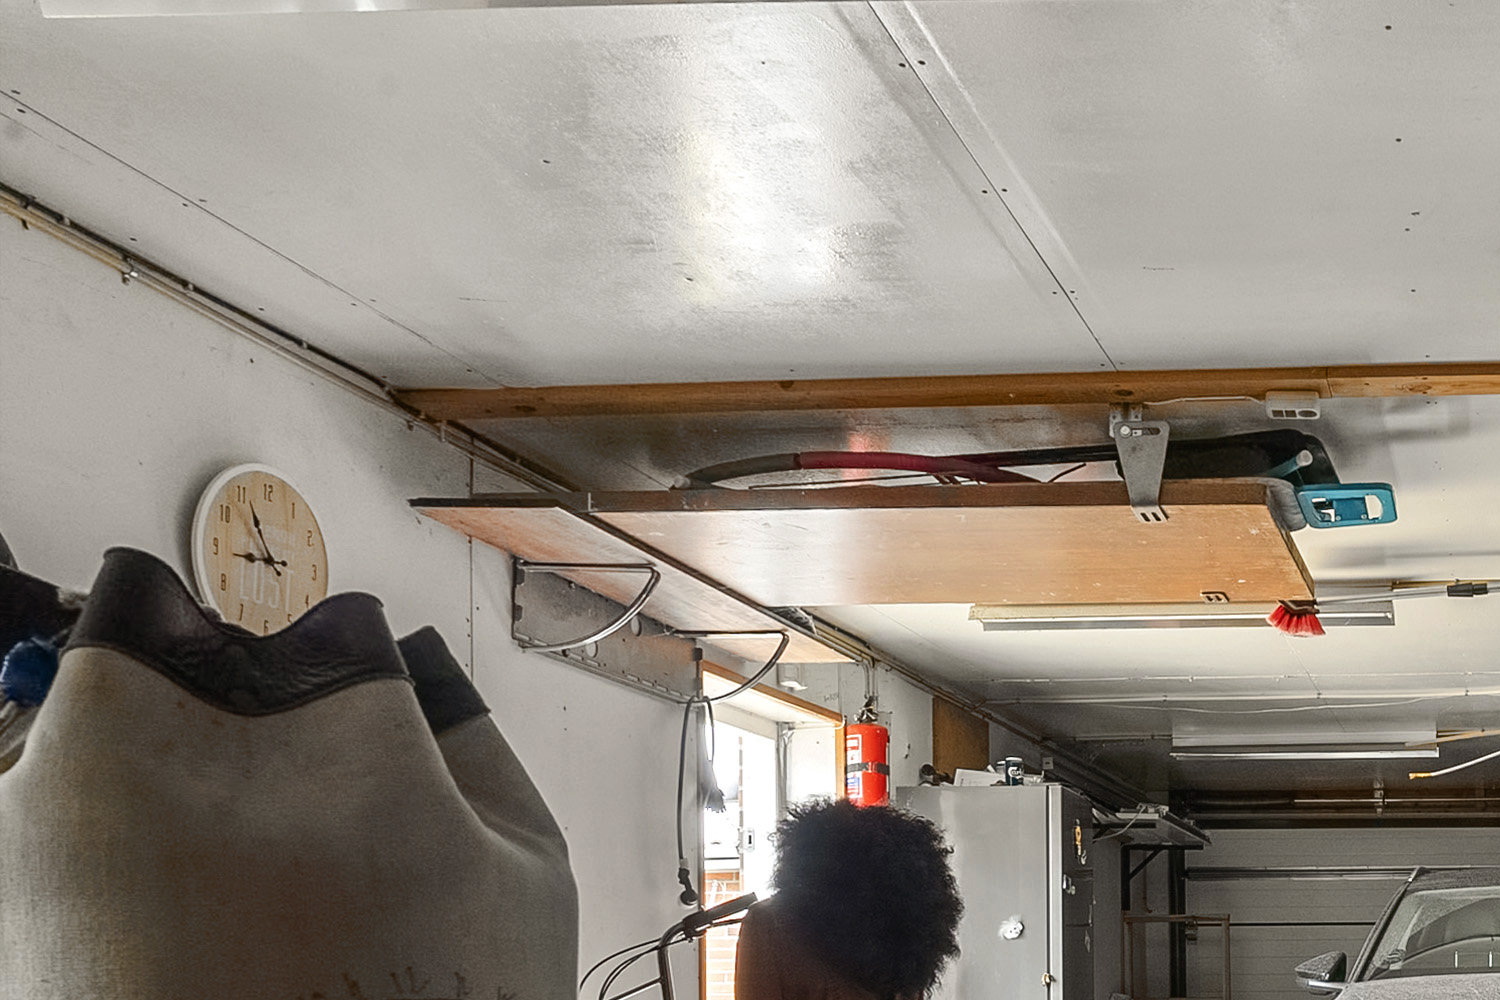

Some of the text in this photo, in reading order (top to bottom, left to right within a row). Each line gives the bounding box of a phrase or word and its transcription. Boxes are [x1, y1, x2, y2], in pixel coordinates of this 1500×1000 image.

[237, 485, 247, 504] 11
[263, 483, 274, 502] 12
[219, 504, 231, 523] 10
[291, 502, 296, 519] 1
[212, 537, 219, 555] 9
[307, 530, 314, 547] 2
[311, 564, 318, 581] 3
[220, 573, 227, 591] 8
[238, 603, 244, 622] 7
